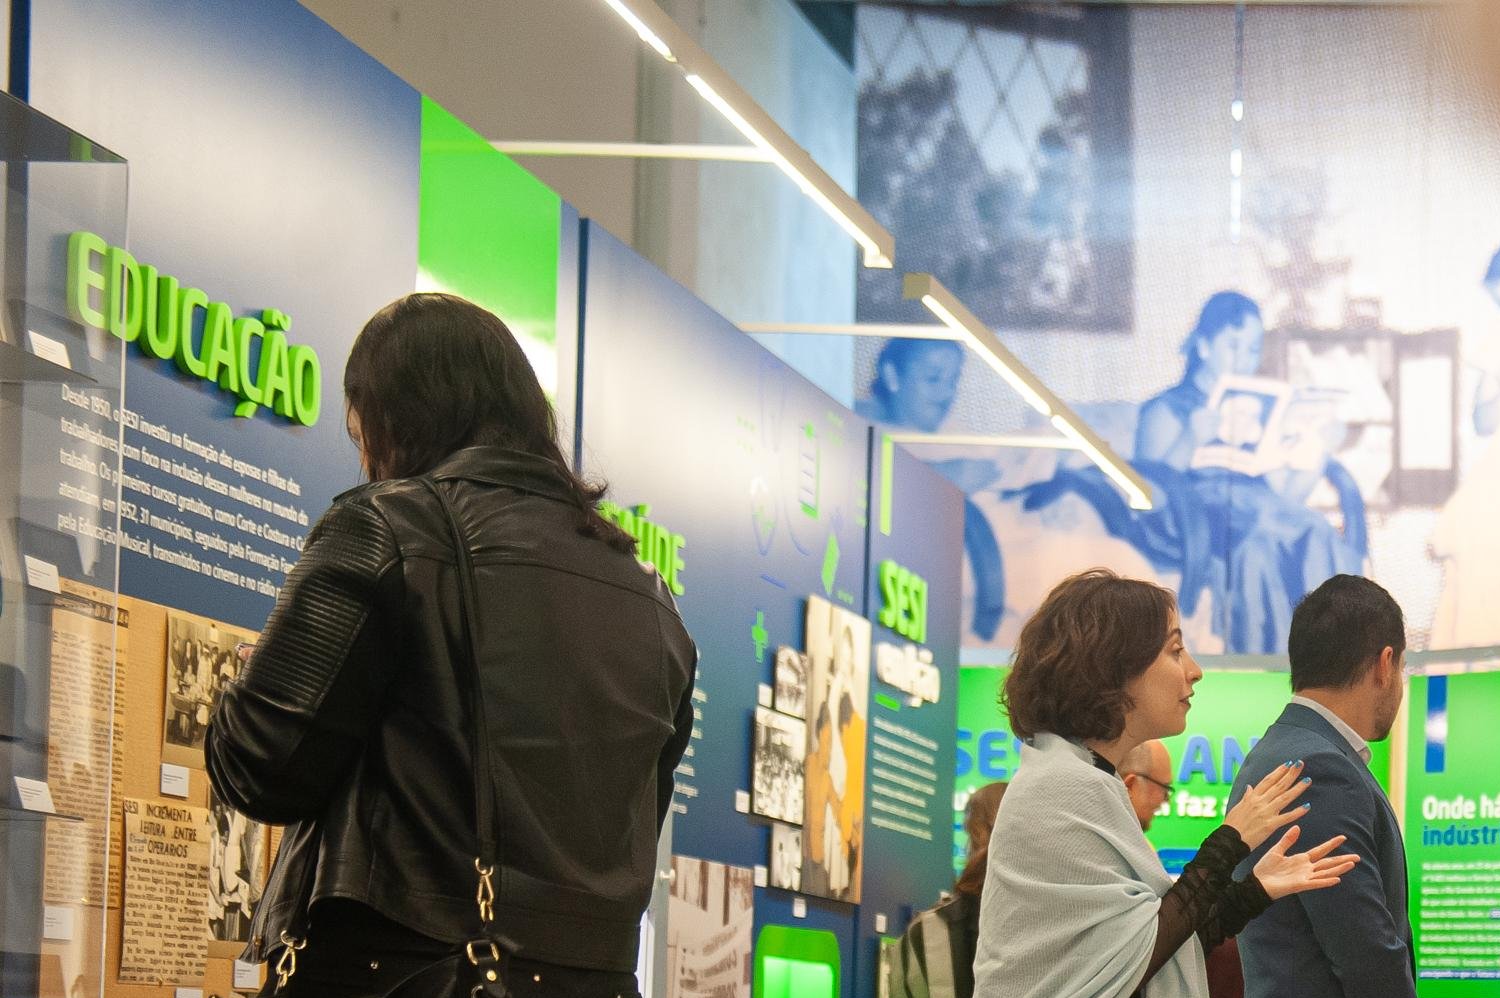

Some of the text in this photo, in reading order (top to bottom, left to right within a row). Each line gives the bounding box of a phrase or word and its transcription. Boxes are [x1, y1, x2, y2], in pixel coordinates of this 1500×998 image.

[67, 231, 321, 427] EDUCAÇÃO
[62, 383, 89, 410] Desde
[139, 416, 171, 443] investiu
[171, 433, 181, 447] na
[183, 435, 218, 462] formação
[233, 459, 261, 480] esposas
[268, 469, 286, 490] filhas
[99, 462, 111, 480] Os
[112, 470, 151, 496] pimeiros
[151, 486, 177, 505] cursos
[178, 495, 212, 520] gratuitos,
[214, 509, 236, 527] como
[236, 514, 257, 535] Corte
[263, 524, 290, 546] Costura
[123, 444, 140, 461] com
[160, 458, 170, 473] na
[171, 459, 203, 486] inclusão
[203, 473, 228, 495] dessas
[228, 485, 261, 508] mulheres
[262, 499, 272, 512] no
[273, 502, 297, 522] mundo
[298, 510, 308, 527] do
[58, 514, 76, 532] pela
[78, 516, 117, 545] Educação
[117, 530, 151, 558] Musical,
[152, 544, 200, 572] transmitidos
[201, 562, 211, 576] no
[212, 564, 239, 586] cinema
[246, 577, 256, 591] no
[256, 578, 275, 598] rádio
[102, 498, 116, 513] em
[119, 500, 137, 522] 952,
[150, 514, 193, 542] municípios,
[194, 530, 228, 553] seguidos
[228, 542, 244, 559] pela
[245, 545, 280, 571] Formação
[879, 559, 928, 644] SESI
[140, 820, 197, 841] LEITURA ENTRE
[147, 804, 192, 822] INCREMENTA
[1175, 791, 1218, 817] faz
[1422, 795, 1476, 820] Onde
